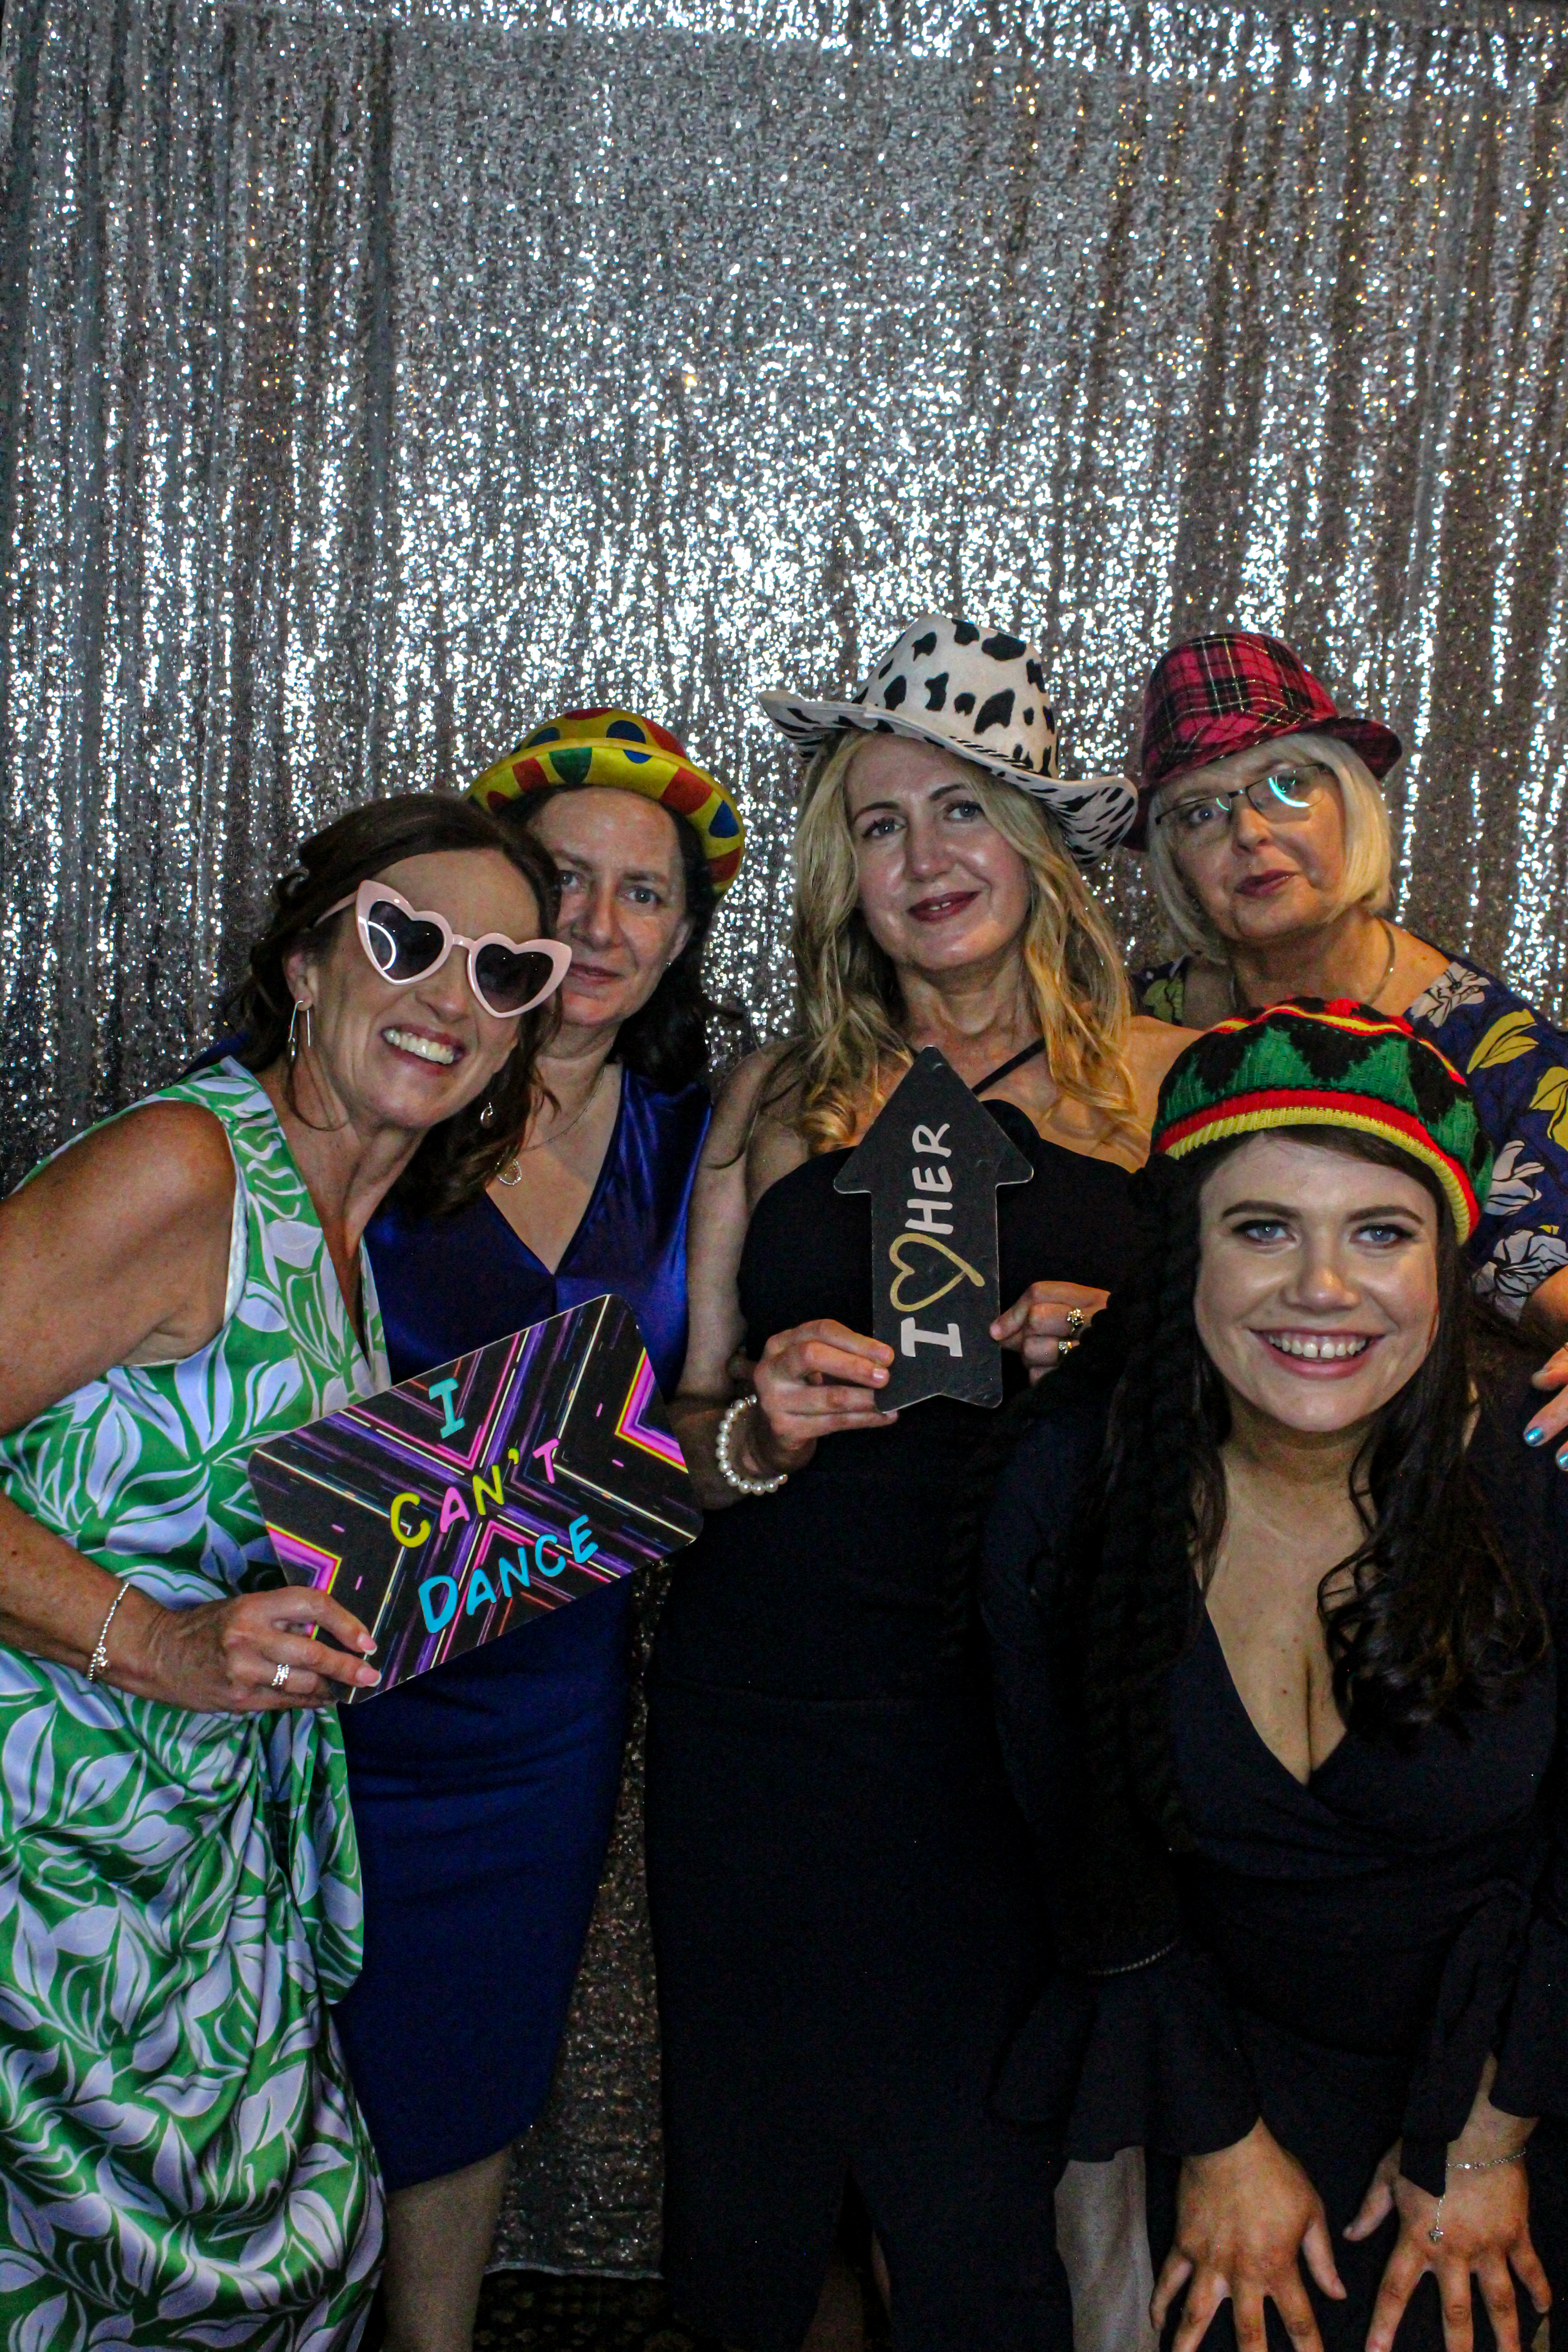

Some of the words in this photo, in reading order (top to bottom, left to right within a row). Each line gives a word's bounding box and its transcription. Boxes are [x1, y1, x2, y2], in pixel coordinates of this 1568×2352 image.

[905, 1122, 954, 1235] HER
[901, 1317, 963, 1357] I
[429, 1377, 465, 1439] I
[390, 1438, 559, 1548] CAN'T
[418, 1514, 598, 1634] DANCE
